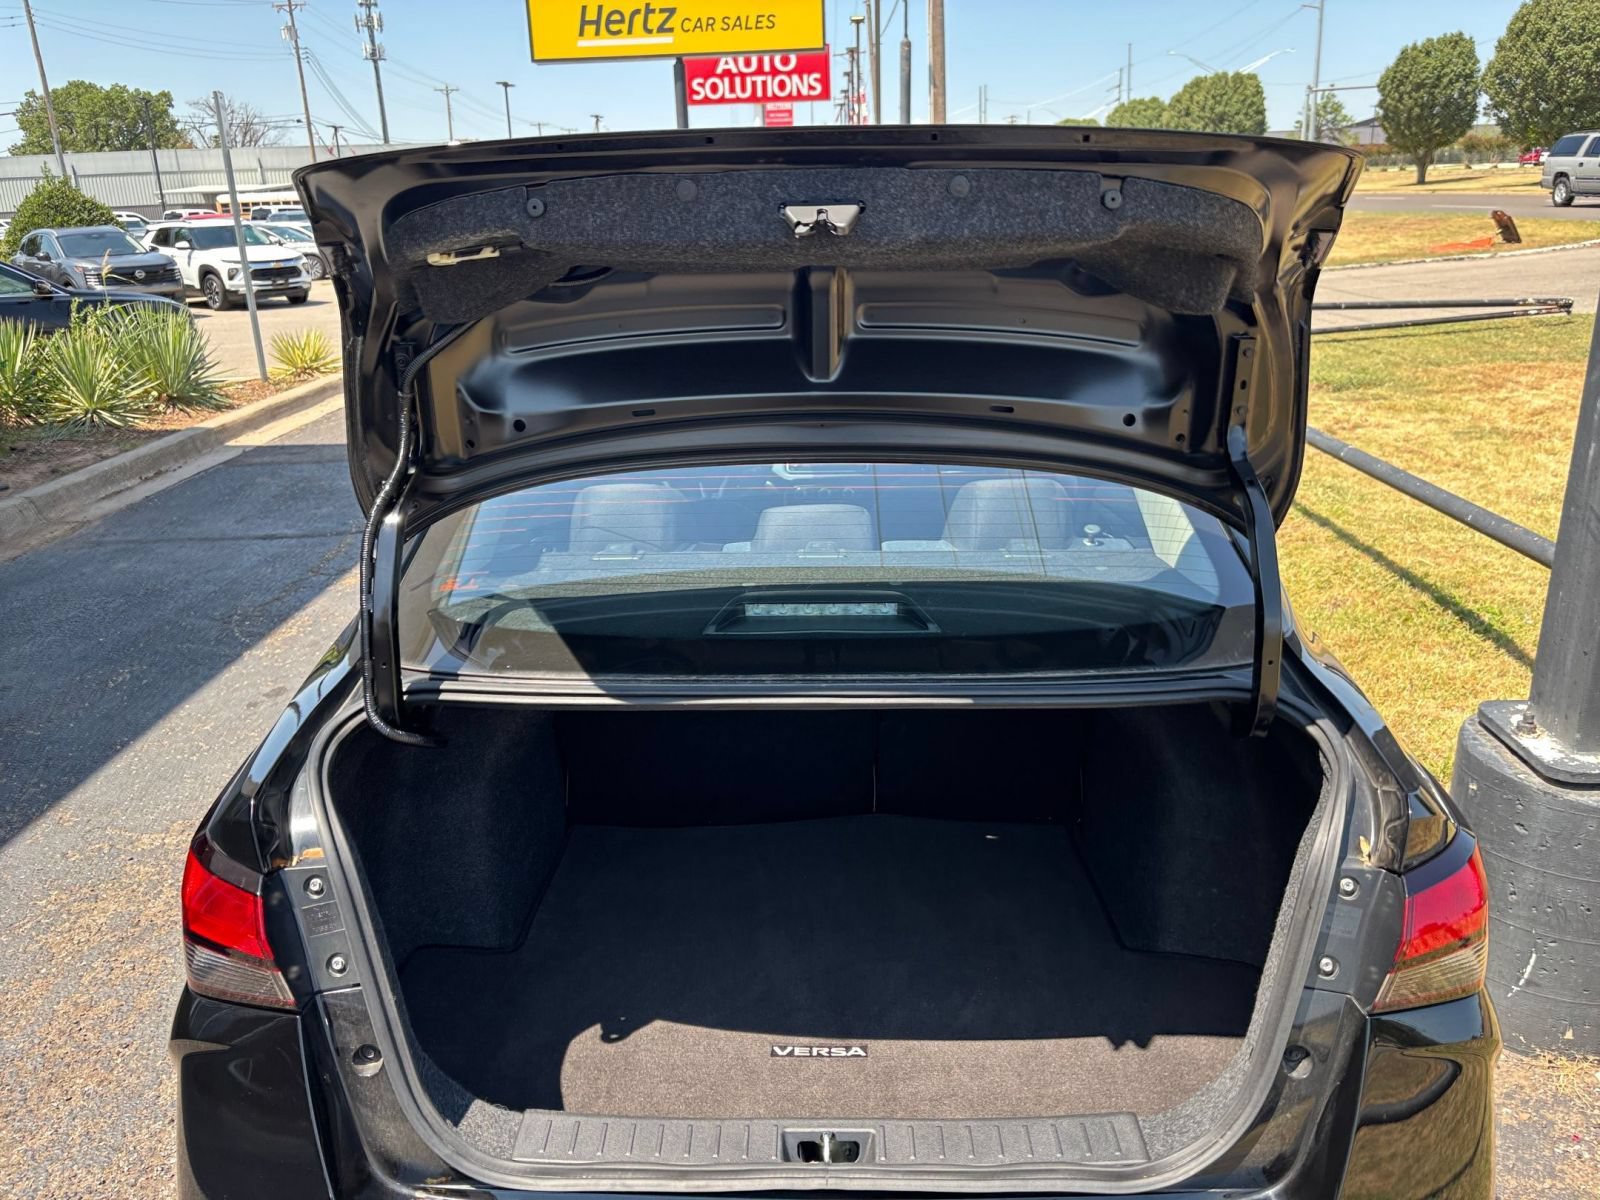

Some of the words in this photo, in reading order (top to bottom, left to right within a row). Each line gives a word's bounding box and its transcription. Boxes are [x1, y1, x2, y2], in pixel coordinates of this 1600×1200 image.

[578, 3, 677, 37] Hertz
[681, 17, 716, 33] CAR
[721, 14, 776, 31] SALES
[715, 54, 797, 75] AUTO
[691, 73, 822, 101] SOLUTIONS
[773, 1046, 867, 1056] VERSA
